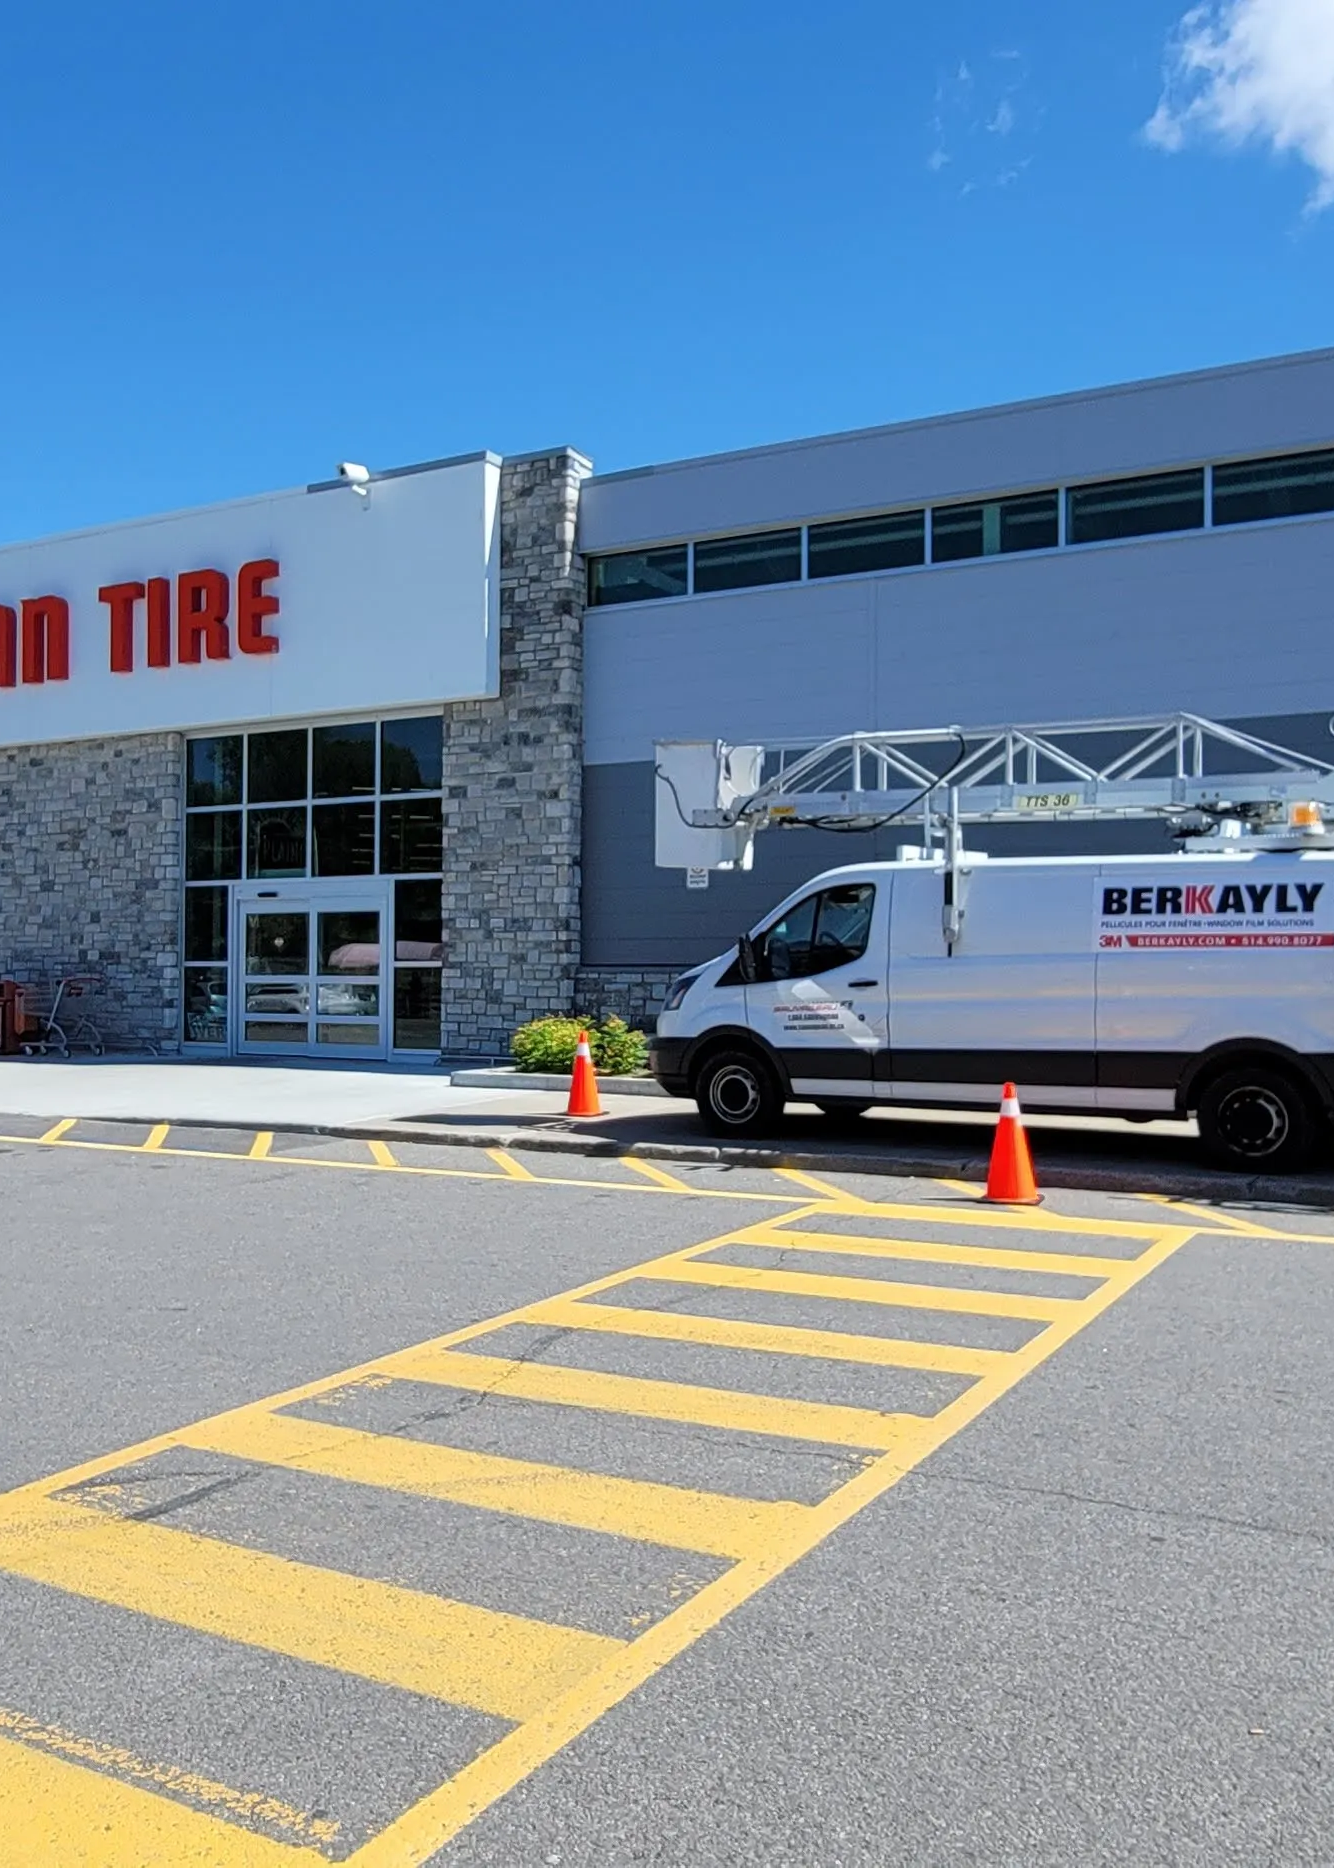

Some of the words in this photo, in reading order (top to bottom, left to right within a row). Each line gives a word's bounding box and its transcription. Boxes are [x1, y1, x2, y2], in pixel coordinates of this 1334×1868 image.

[99, 558, 280, 673] TIRE
[1026, 795, 1049, 807] TTS
[1102, 882, 1324, 915] BERKAYLY
[1101, 920, 1142, 928] PELLICULES
[1145, 920, 1166, 928] POUR
[1246, 919, 1264, 927] FILM
[1267, 918, 1314, 927] SOLUTIONS
[1099, 935, 1122, 948] 3M
[1137, 936, 1226, 946] BERKAYLY.COM
